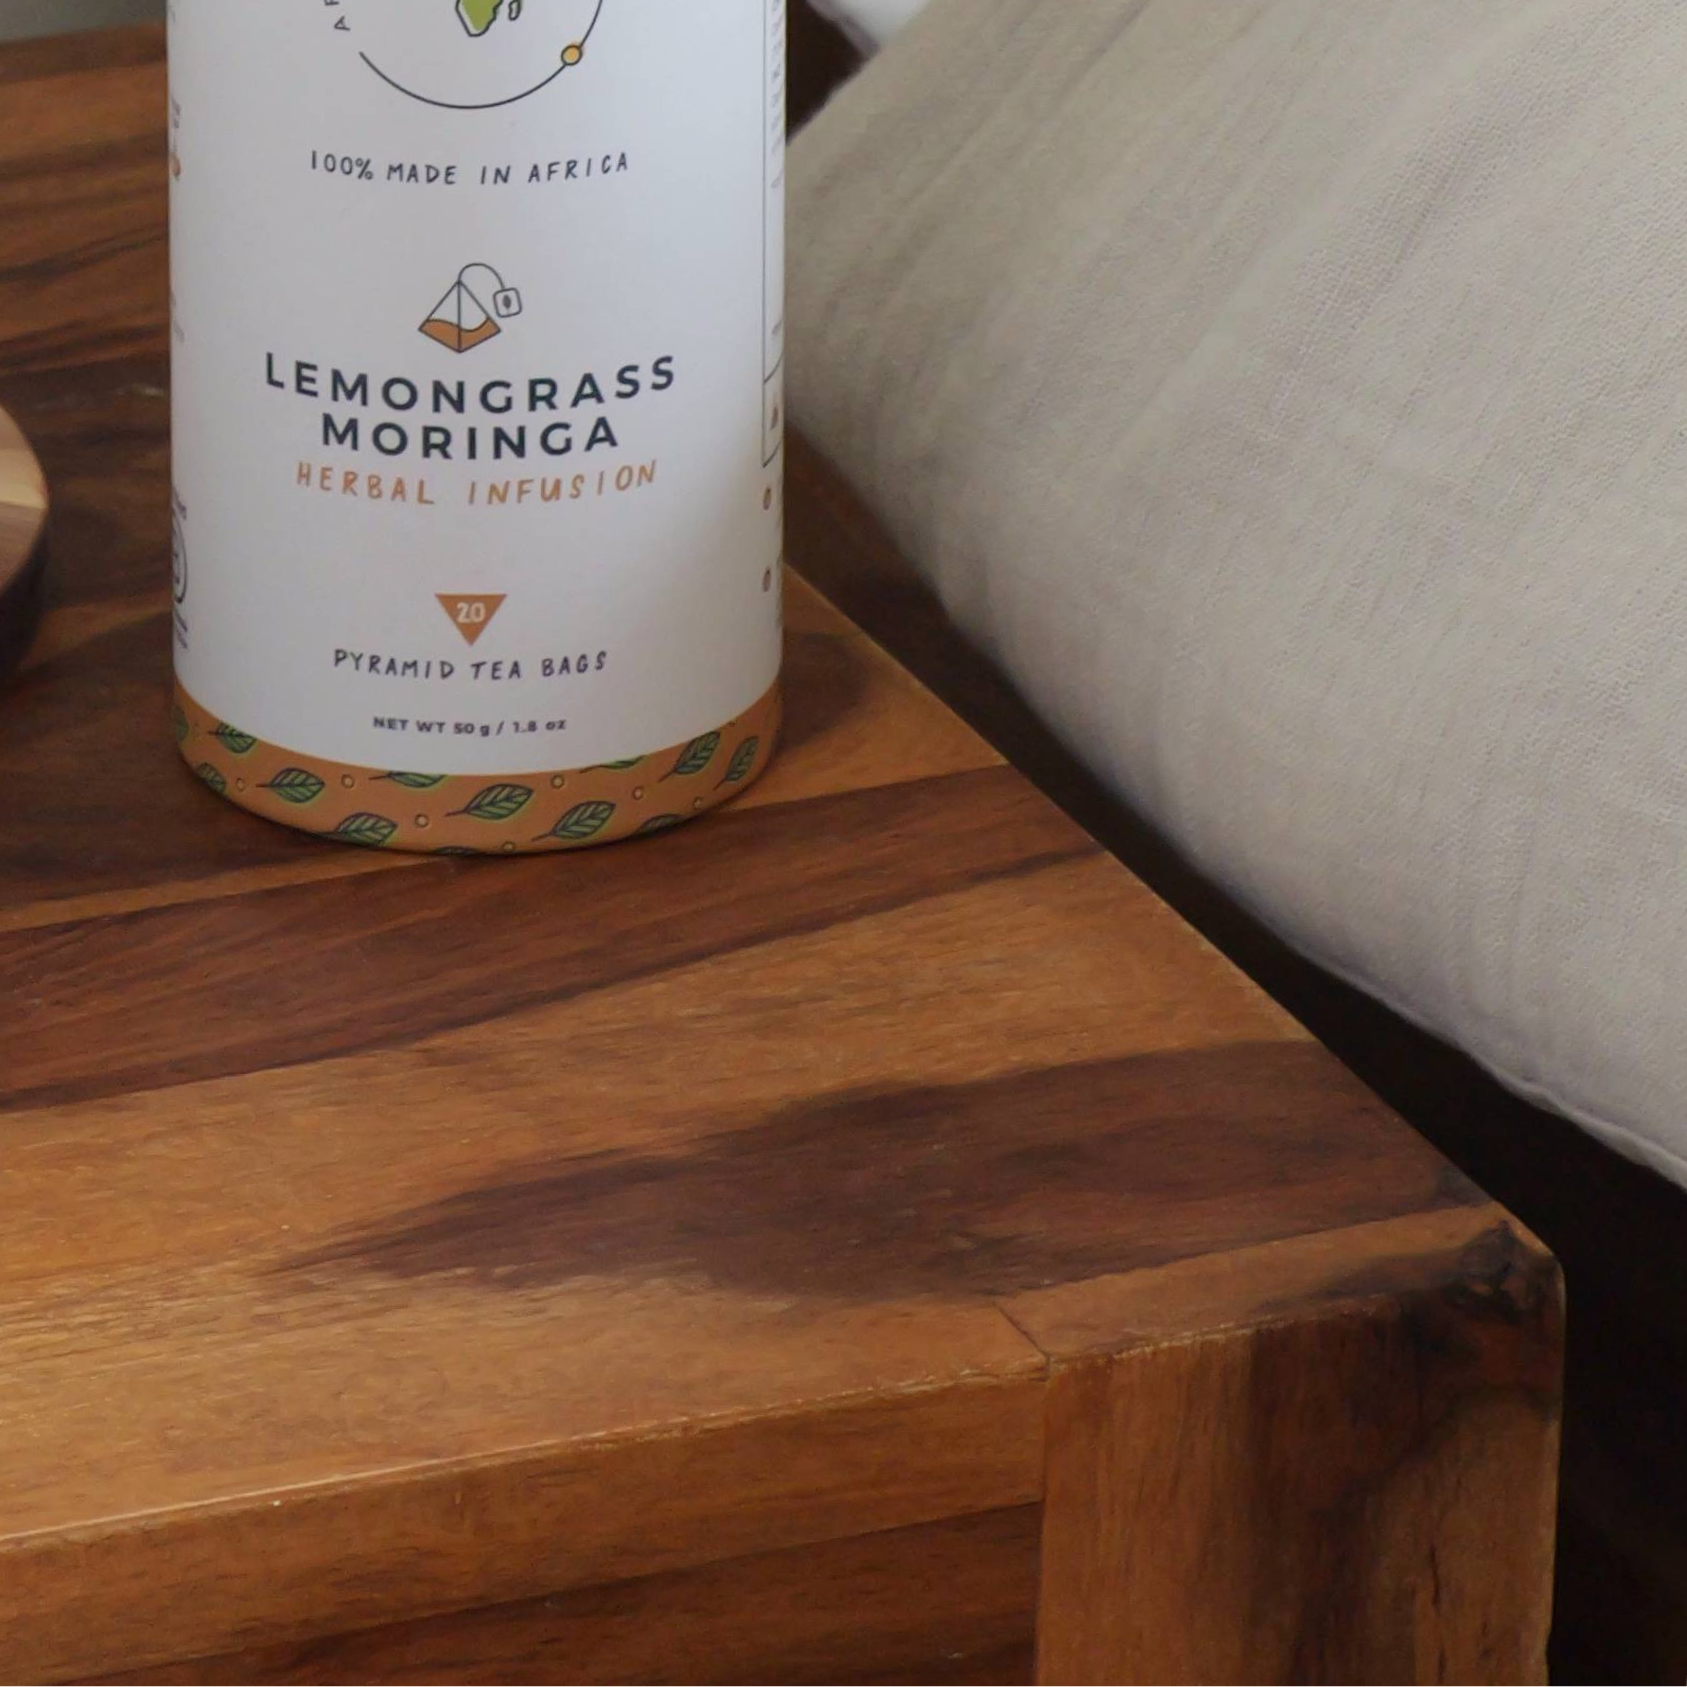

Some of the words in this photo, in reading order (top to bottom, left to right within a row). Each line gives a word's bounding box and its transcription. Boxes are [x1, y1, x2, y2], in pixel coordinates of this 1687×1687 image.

[310, 150, 374, 181] 100%
[386, 163, 457, 185] MADE
[479, 165, 511, 185] IN
[527, 152, 628, 184] AFRICA
[265, 351, 675, 414] LEMONGRASS
[321, 412, 618, 460] MORINGA
[296, 461, 435, 505] HERBAL
[468, 459, 658, 505] INFUSION
[456, 602, 486, 623] 20
[334, 648, 455, 680] PYRAMID
[470, 661, 522, 680] TEA
[541, 650, 607, 677] BAGS
[373, 716, 409, 732] NET
[416, 720, 446, 734] WT
[512, 720, 537, 733] 1.8
[545, 719, 567, 732] oz
